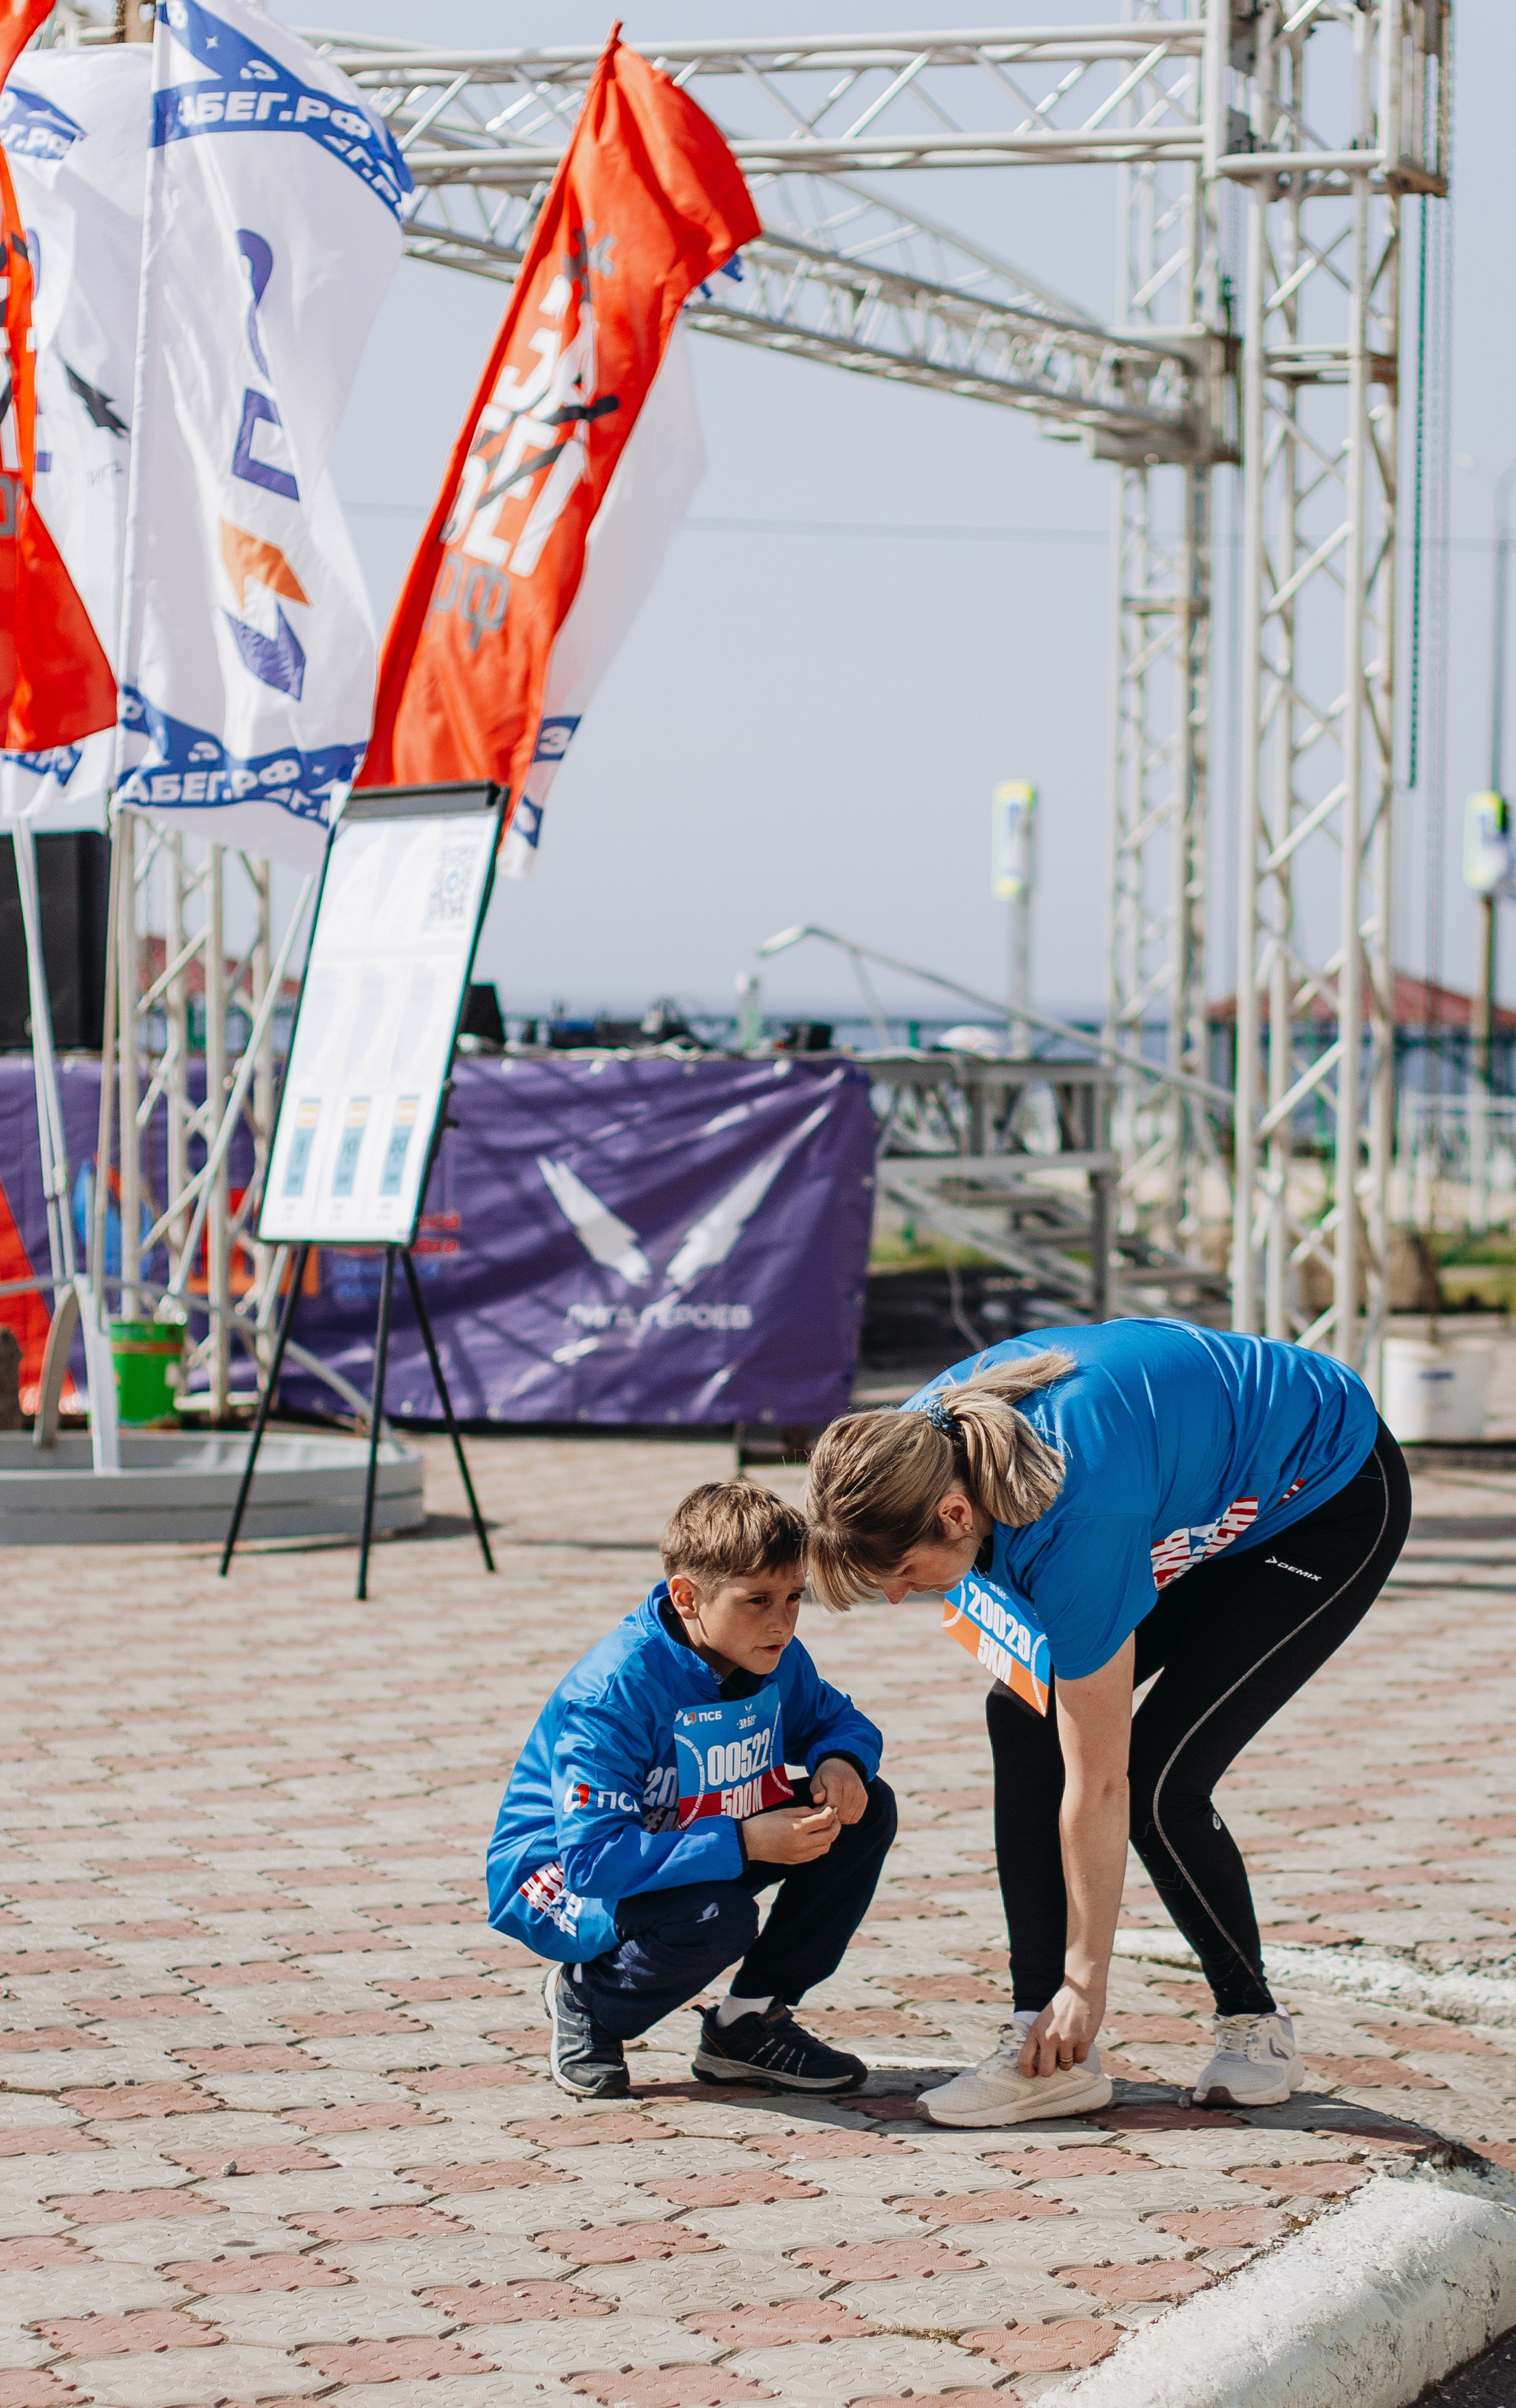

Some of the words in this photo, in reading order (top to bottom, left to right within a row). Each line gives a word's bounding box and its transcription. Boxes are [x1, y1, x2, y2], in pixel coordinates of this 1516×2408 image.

[178, 91, 371, 140] АБЕГ.РФ
[123, 759, 301, 803] АБЕГ.РФ
[1277, 1562, 1322, 1581] DEMIX
[968, 1581, 1031, 1662] 20029
[699, 1710, 722, 1722] ПСБ
[708, 1728, 770, 1786] 00522
[721, 1775, 763, 1819] 500М
